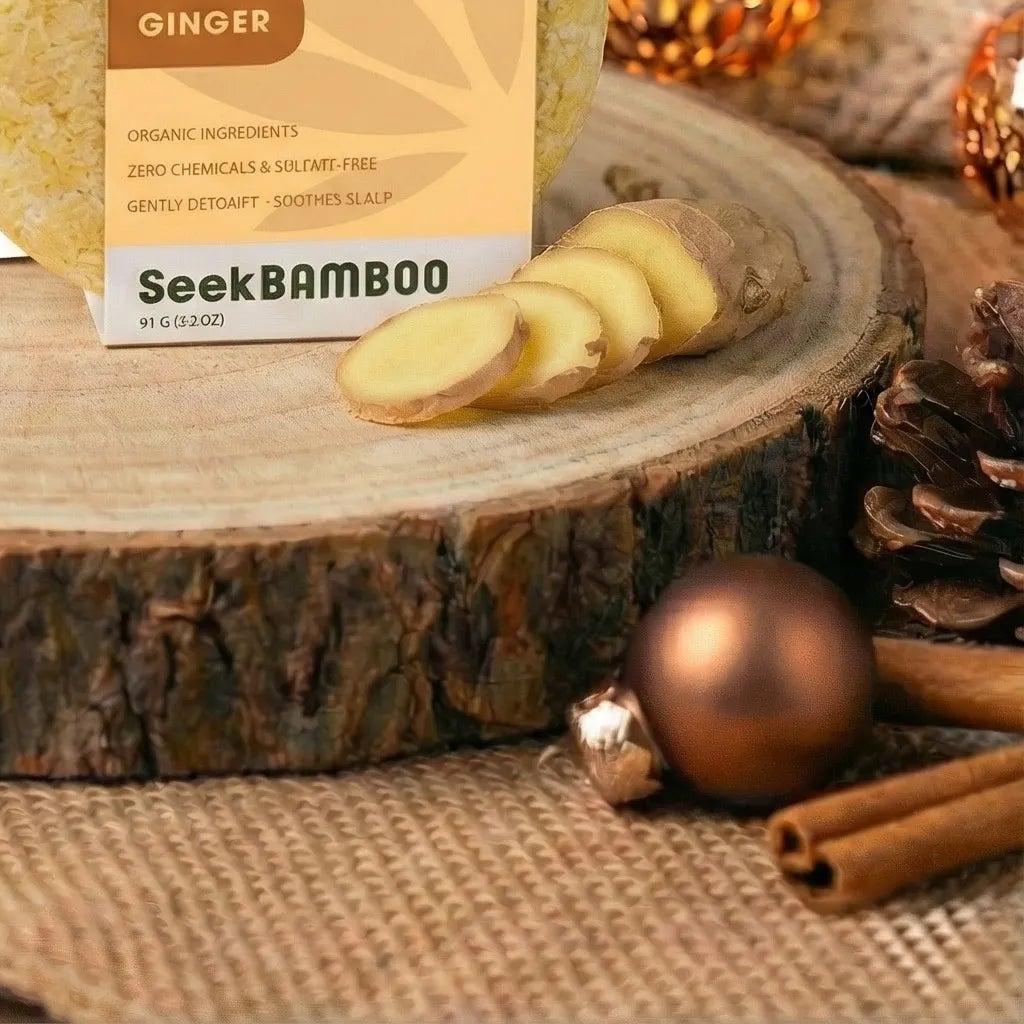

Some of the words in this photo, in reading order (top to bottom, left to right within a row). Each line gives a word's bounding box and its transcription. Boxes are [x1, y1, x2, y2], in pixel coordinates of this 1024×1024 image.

[138, 9, 270, 37] GINGER
[127, 127, 196, 143] ORGANIC
[200, 124, 299, 141] INGREDIENTS
[127, 163, 167, 178] ZERO
[170, 160, 256, 176] CHEMICALS
[259, 160, 272, 174] &
[127, 198, 183, 213] GENTLY
[273, 192, 342, 208] SOOTHES
[138, 259, 449, 305] SeekBAMBOO
[139, 317, 154, 330] 91
[159, 315, 171, 328] G
